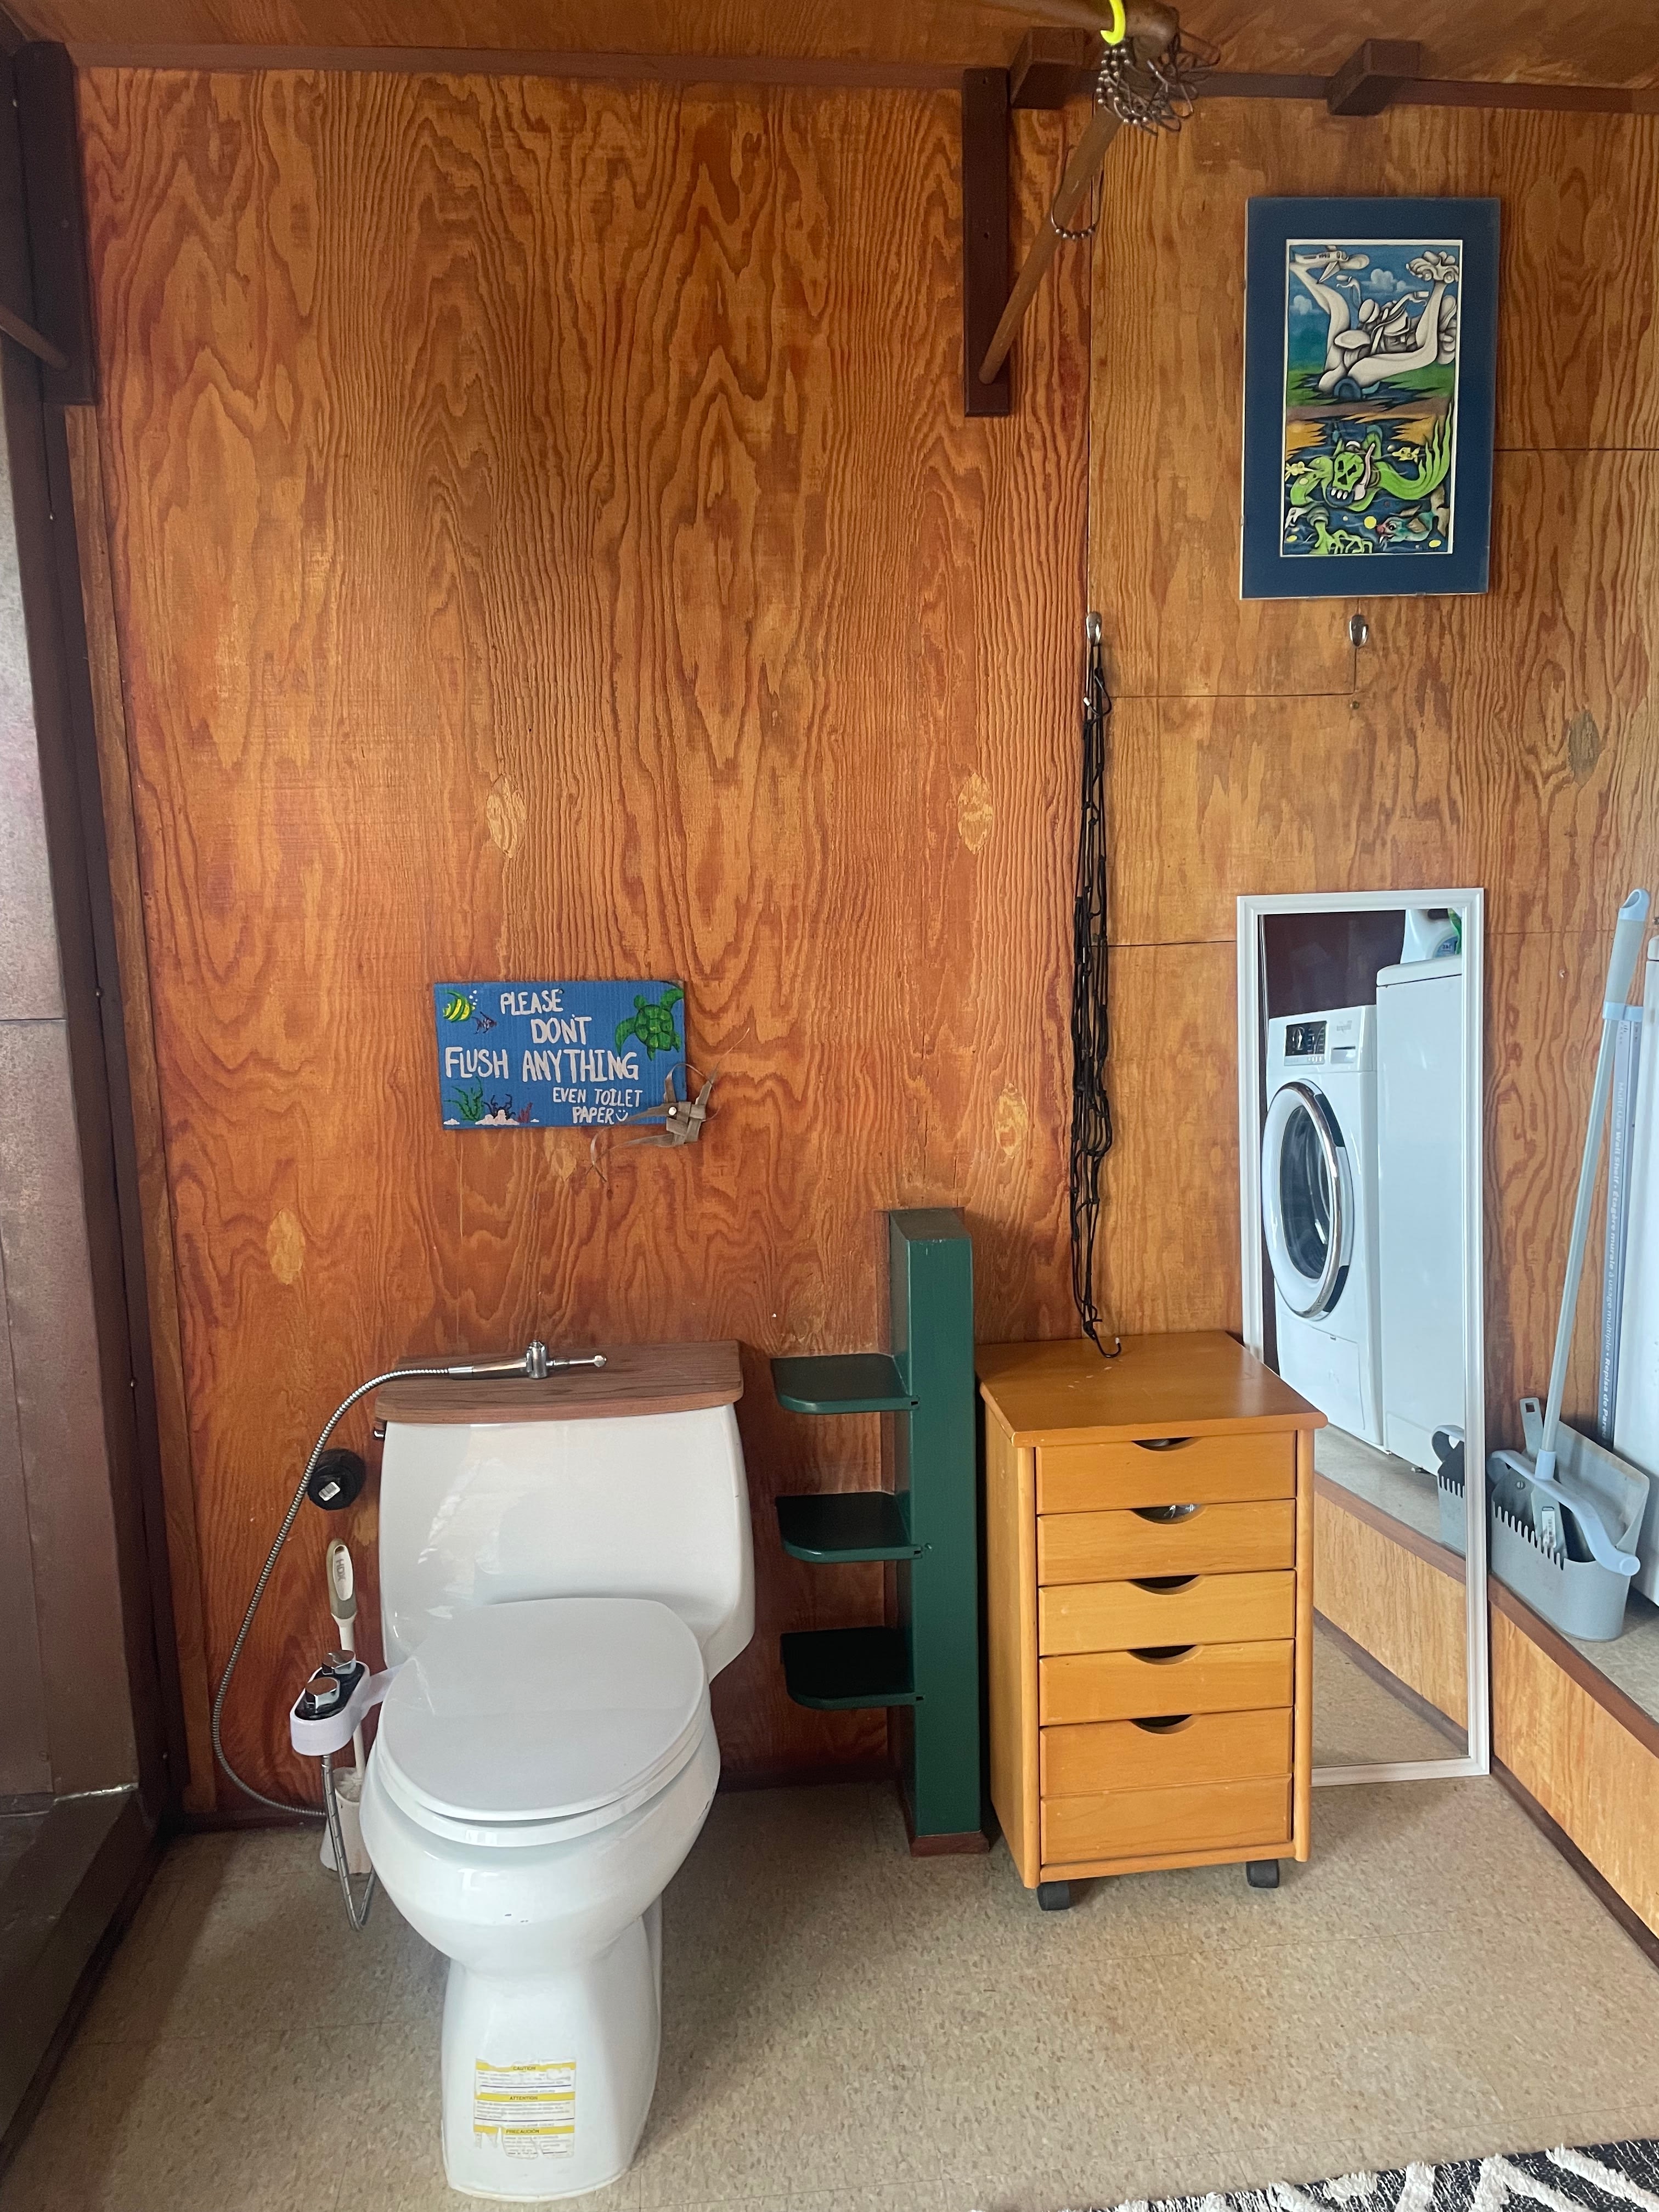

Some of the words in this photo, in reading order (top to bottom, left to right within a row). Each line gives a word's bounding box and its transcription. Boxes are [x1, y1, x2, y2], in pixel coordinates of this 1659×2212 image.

[500, 989, 564, 1016] PLEASE
[445, 1046, 509, 1080] FLUSH
[522, 1048, 639, 1083] ANYTHING
[552, 1087, 587, 1104] EVEN
[595, 1088, 643, 1107] TOILET
[1616, 1082, 1624, 1129] Multi-Use
[572, 1107, 615, 1125] PAPER
[1610, 1191, 1620, 1231] Étagère
[1604, 1310, 1612, 1351] multiple
[1602, 1393, 1609, 1407] de
[336, 1559, 346, 1582] HDX
